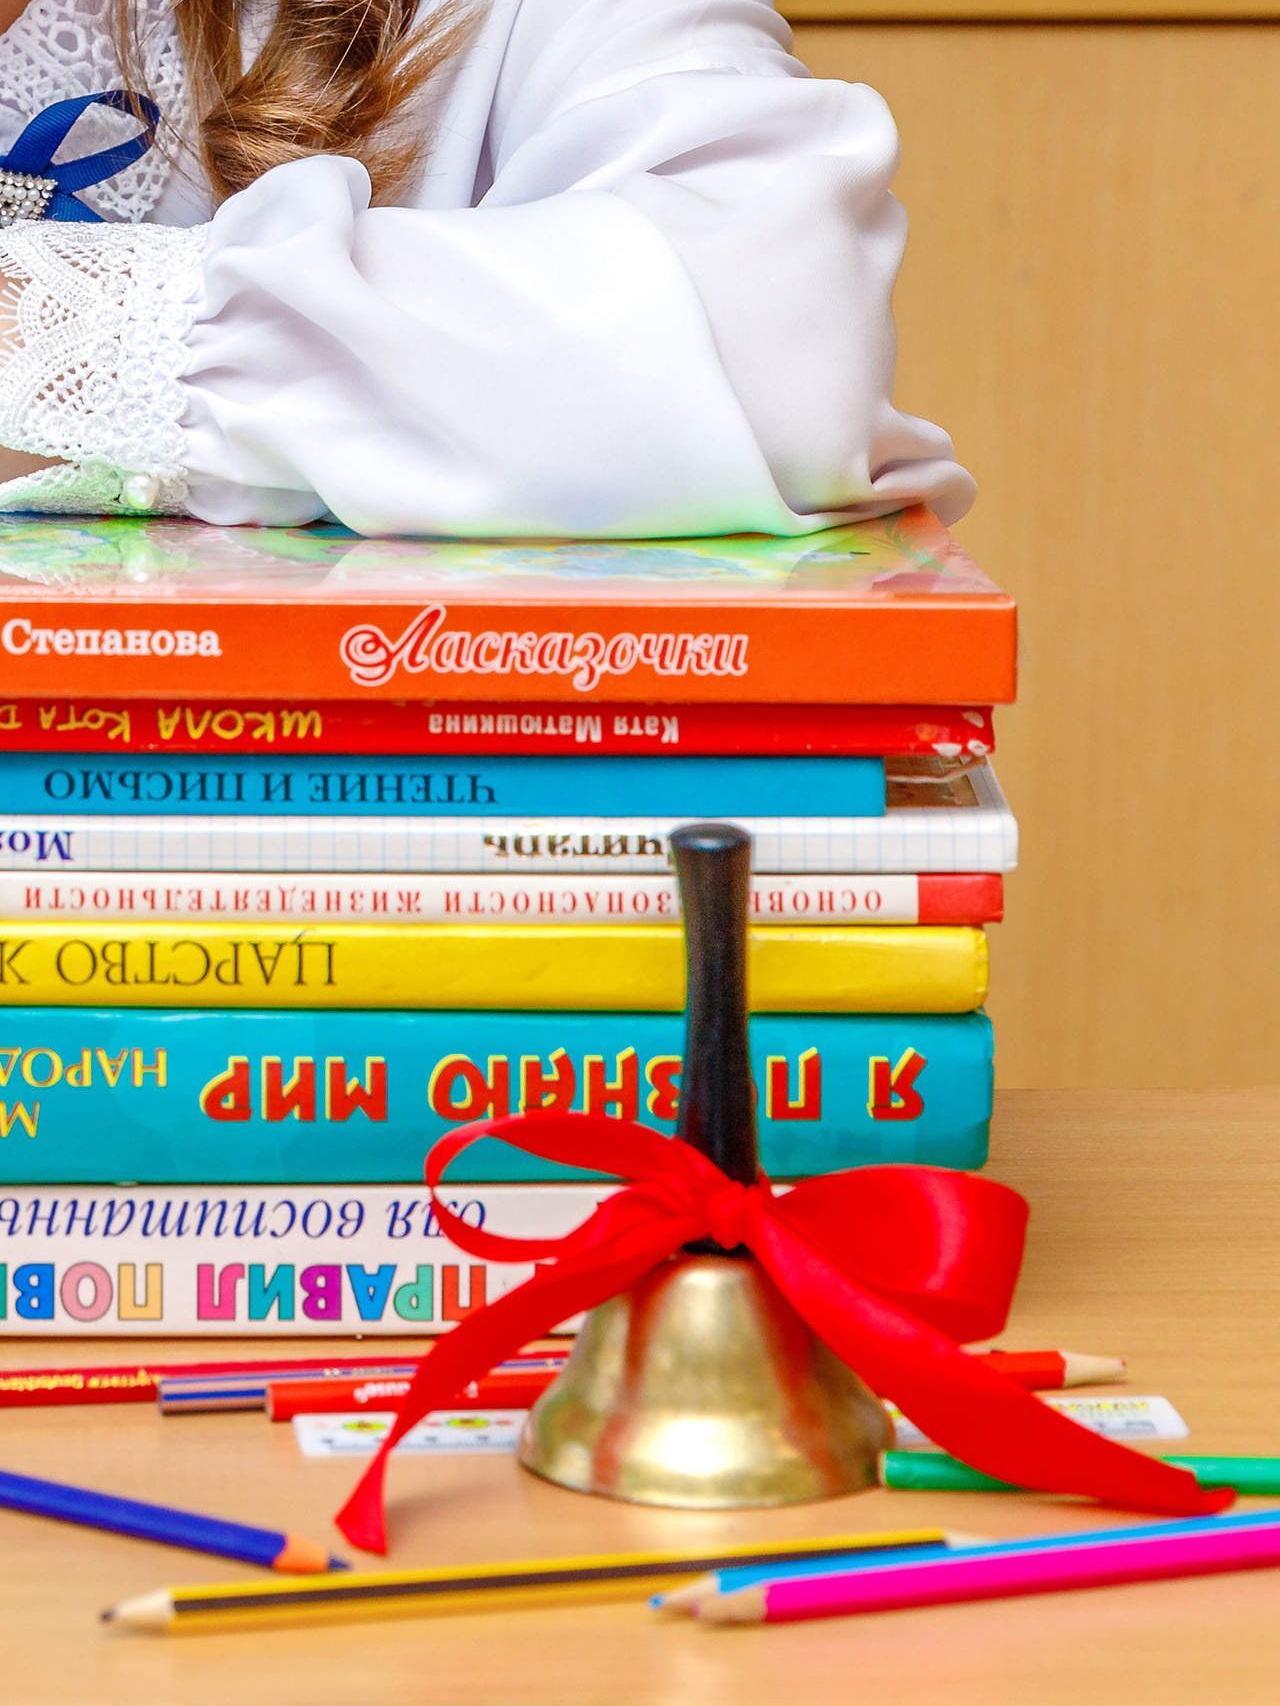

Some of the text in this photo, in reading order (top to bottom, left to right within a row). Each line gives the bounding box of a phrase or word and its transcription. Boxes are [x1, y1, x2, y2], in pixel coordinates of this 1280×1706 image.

[0, 618, 222, 658] Степанова
[339, 604, 749, 691] Ласказочки
[428, 712, 679, 744] Катя Матюшкина
[43, 771, 498, 805] ЧТЕНИЕ И ПИСЬМО
[482, 825, 673, 866] читарь
[25, 886, 422, 914] ЖИЗНЕДЕЯТЕЛЬНОСТИ
[444, 886, 683, 916] ЗОПАСНОСТИ
[56, 930, 338, 986] ЦАРСТВО
[200, 1047, 926, 1122] Я ПЗНАЮ МИР
[197, 1263, 488, 1322] ПРАВИЛ
